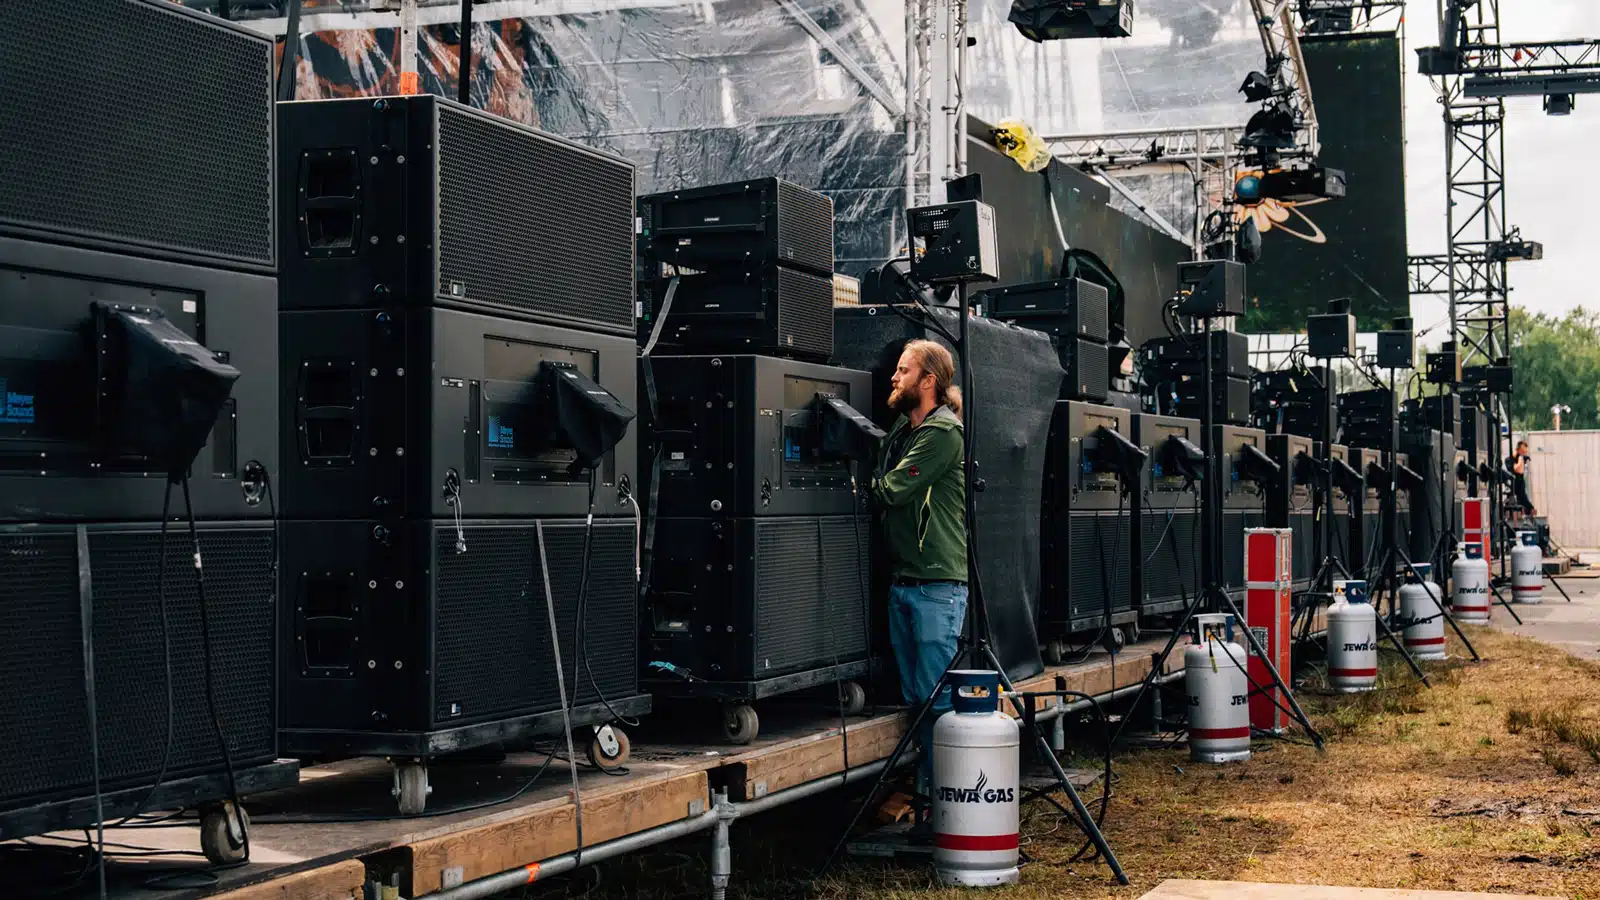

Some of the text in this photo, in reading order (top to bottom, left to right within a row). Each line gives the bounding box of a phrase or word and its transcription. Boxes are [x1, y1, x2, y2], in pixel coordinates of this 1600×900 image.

[1342, 643, 1369, 652] JEWA
[1231, 694, 1248, 706] JEW
[938, 786, 1014, 803] JEWA GAS
